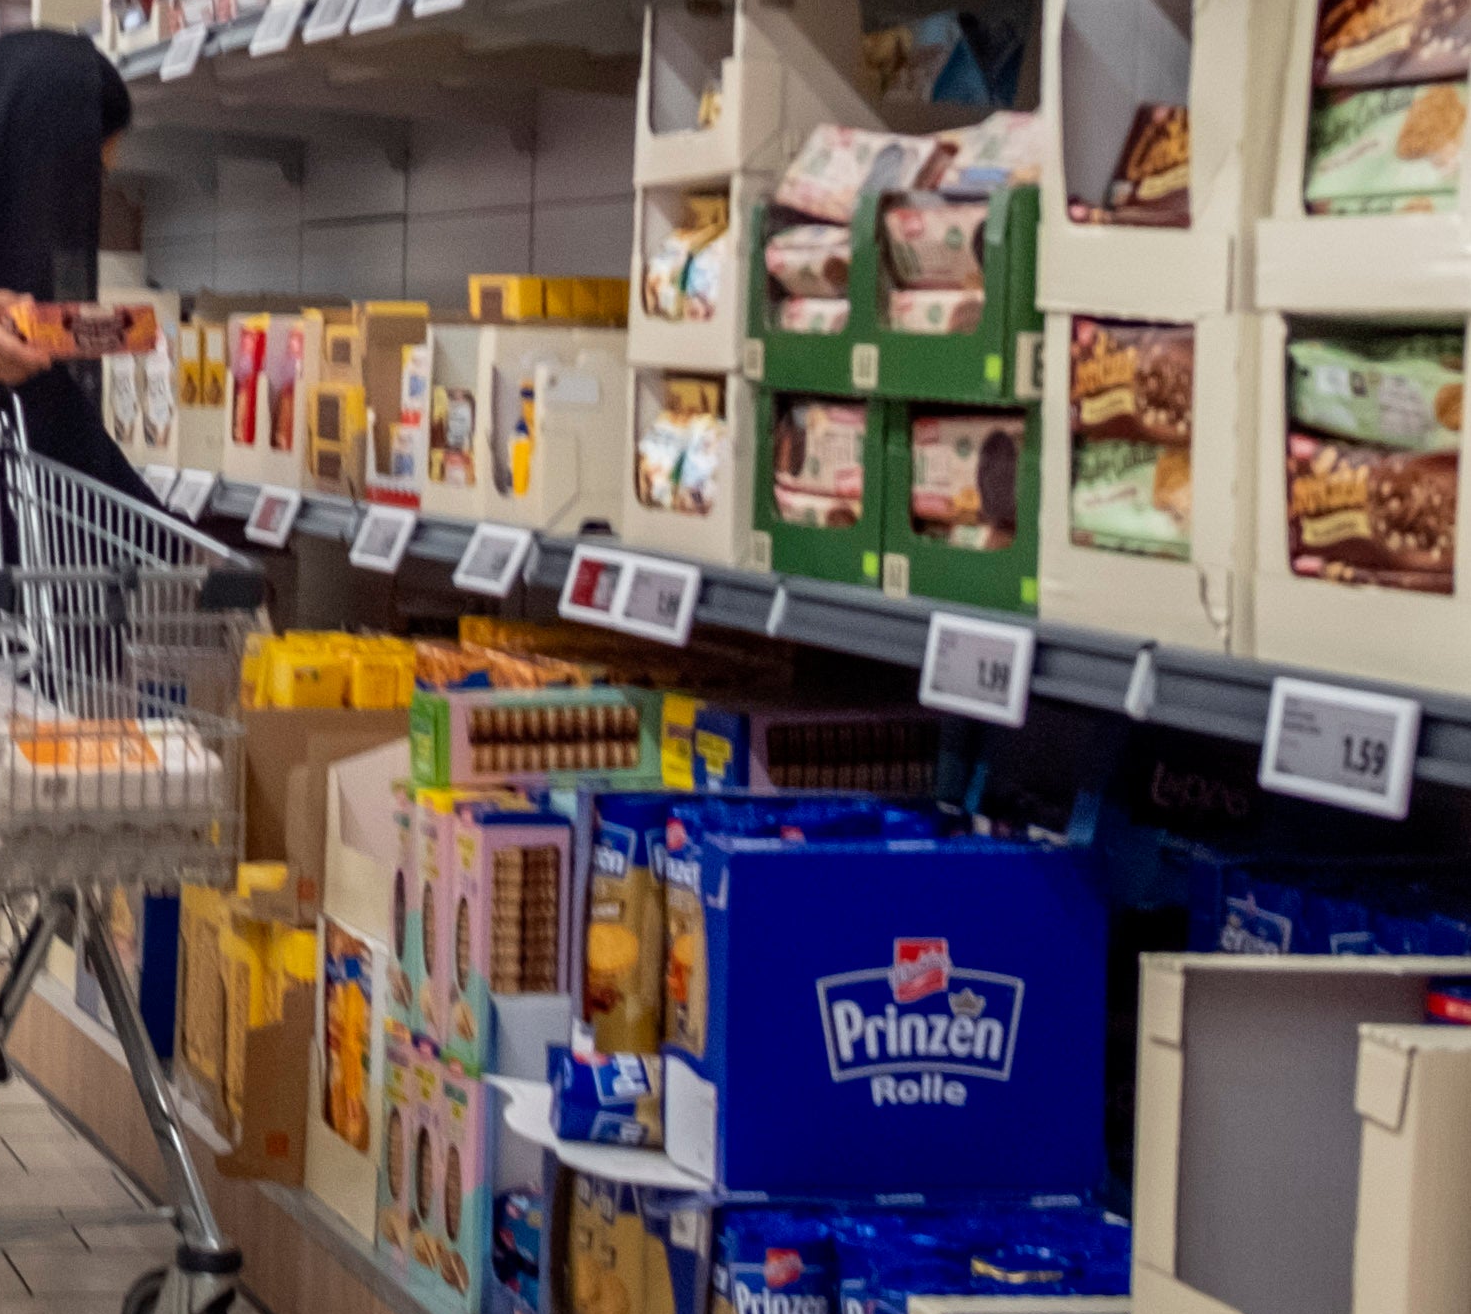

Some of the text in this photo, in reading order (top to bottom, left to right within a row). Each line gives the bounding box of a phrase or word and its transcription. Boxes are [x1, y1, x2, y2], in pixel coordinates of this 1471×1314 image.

[1341, 732, 1388, 779] 1.59
[831, 999, 1004, 1062] Prinzen
[870, 1072, 968, 1108] Rolle
